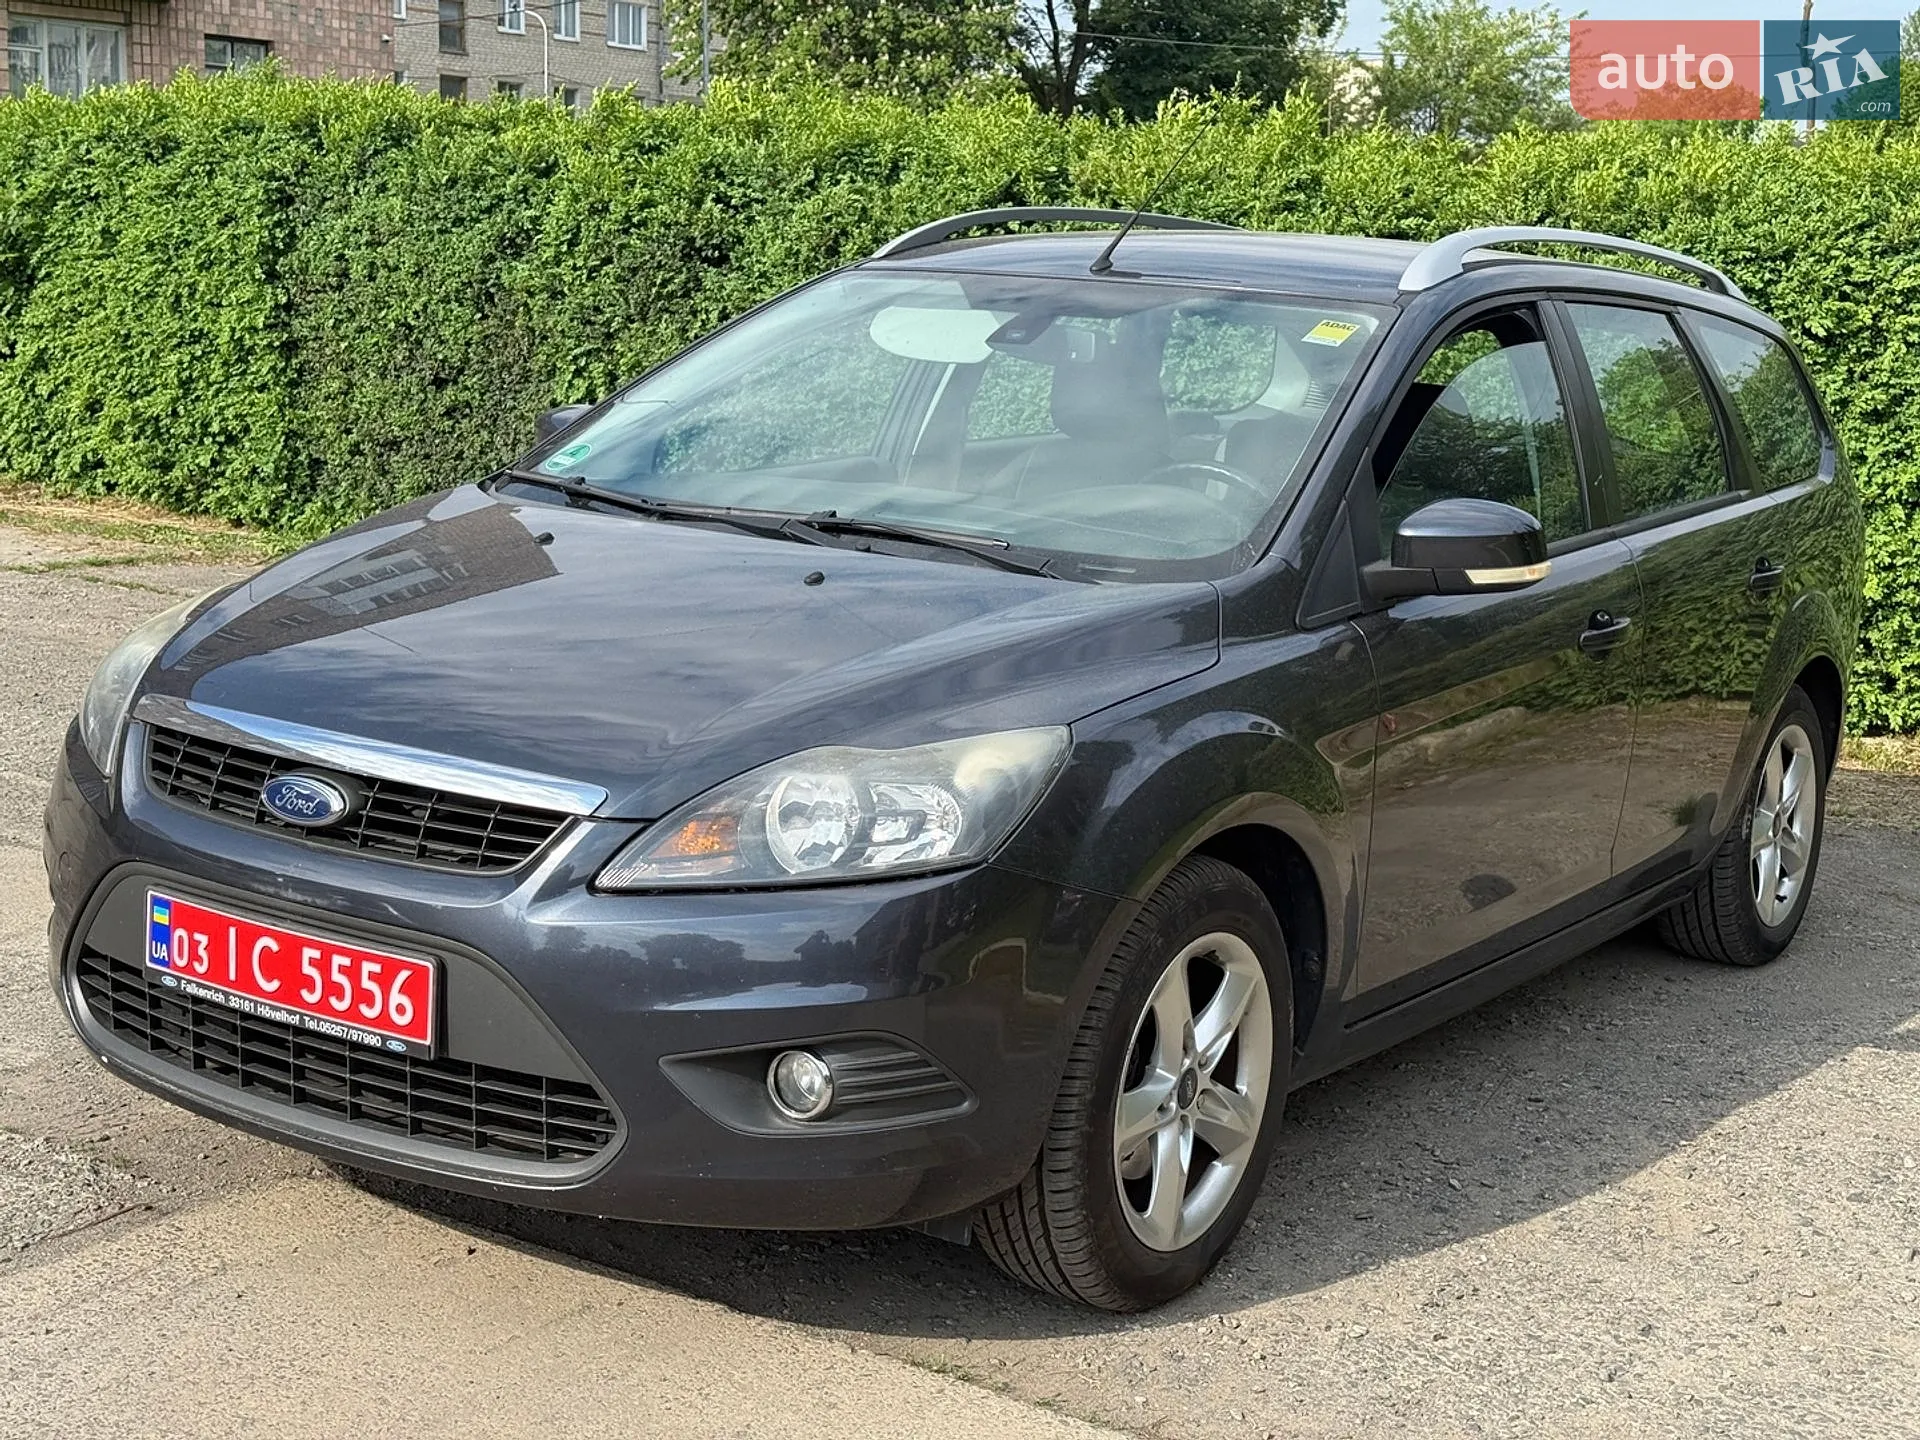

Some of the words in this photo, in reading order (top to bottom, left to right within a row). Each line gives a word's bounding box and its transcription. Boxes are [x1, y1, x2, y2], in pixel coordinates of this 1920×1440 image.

[1320, 321, 1356, 331] ADAC
[275, 784, 319, 815] Ford
[152, 941, 169, 961] UA
[172, 928, 209, 974] 03
[299, 946, 416, 1026] 5556
[180, 980, 225, 1003] Falkenrich
[228, 995, 255, 1013] 33161
